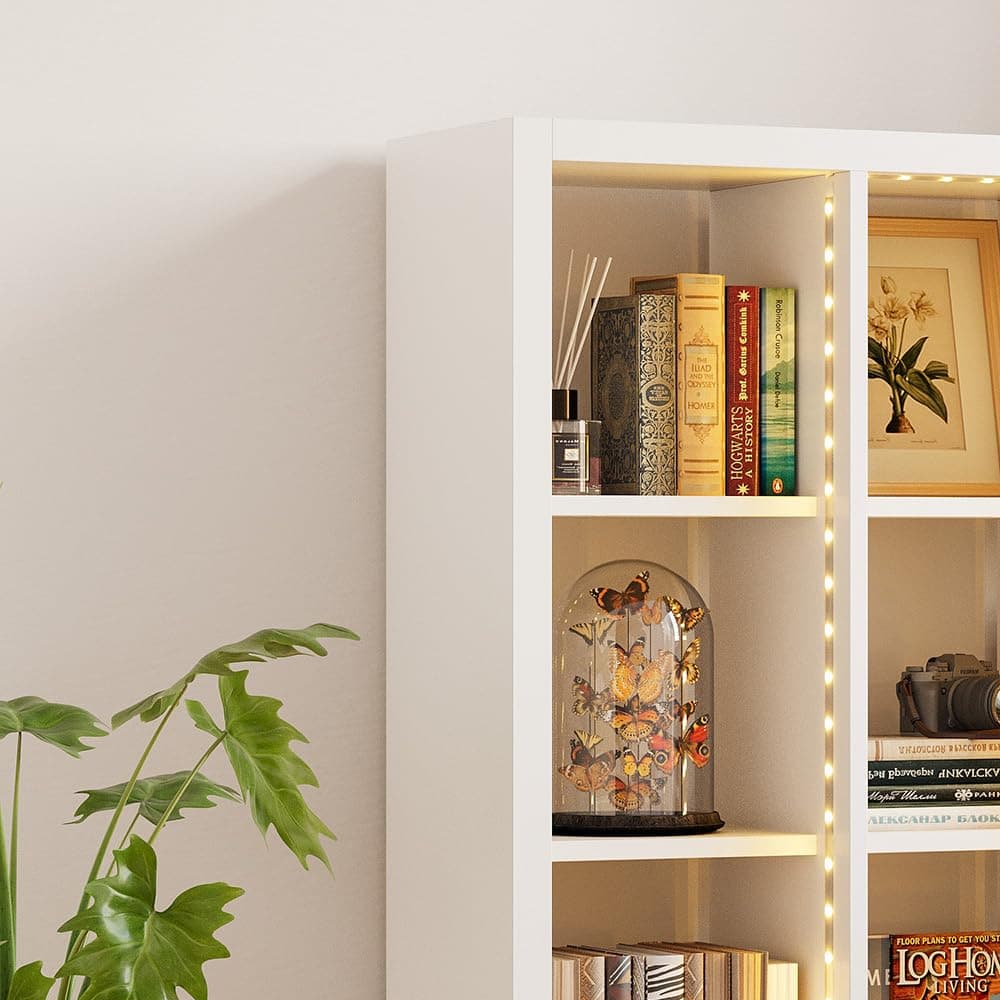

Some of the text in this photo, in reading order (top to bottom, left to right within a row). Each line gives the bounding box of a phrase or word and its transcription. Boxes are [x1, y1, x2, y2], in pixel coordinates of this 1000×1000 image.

[774, 299, 783, 359] Robinson Crusoe
[691, 363, 712, 372] ILIAD
[687, 401, 715, 410] HOMER
[730, 407, 744, 480] HOGWARTS
[745, 407, 753, 478] A HISTORY
[868, 814, 952, 825] ЛЕКСАНДР
[957, 814, 1000, 823] БЛОК
[896, 937, 920, 946] FLOOR
[922, 937, 945, 945] PLANS
[947, 936, 957, 944] TO
[959, 935, 973, 944] GET
[975, 935, 989, 943] YOU
[935, 979, 988, 994] LIVING
